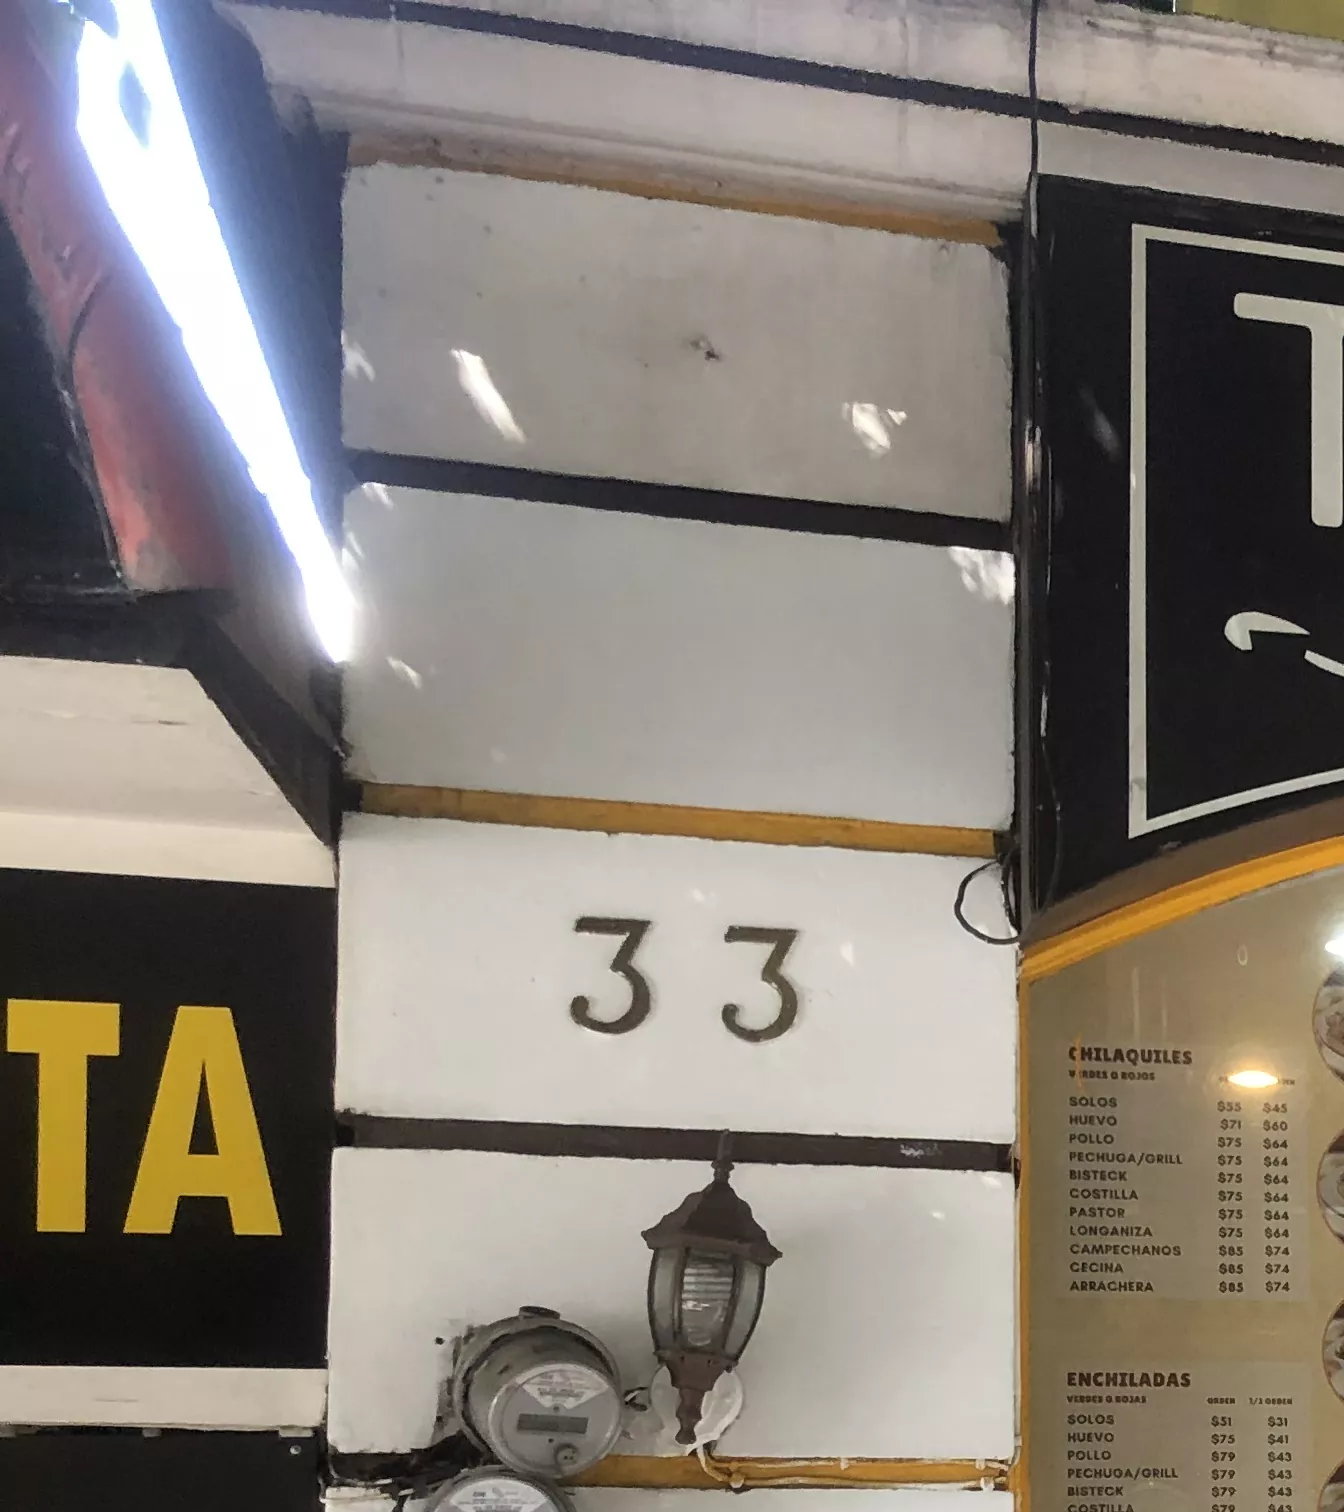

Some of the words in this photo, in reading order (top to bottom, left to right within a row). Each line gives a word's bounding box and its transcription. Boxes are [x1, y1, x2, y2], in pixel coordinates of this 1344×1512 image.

[1068, 1046, 1193, 1067] CHILAQUILES
[6, 999, 282, 1236] TA
[1069, 1114, 1117, 1127] HUEVO
[1219, 1118, 1242, 1131] $71
[1262, 1119, 1288, 1132] $60
[1069, 1151, 1183, 1166] PECHUGA/GRILL
[1217, 1153, 1243, 1167] $75
[1263, 1155, 1289, 1168] $64
[1067, 1371, 1191, 1388] ENCHILADAS
[1067, 1432, 1115, 1443] HUEVO
[1211, 1433, 1236, 1446] $75
[1267, 1433, 1289, 1446] $41
[1067, 1450, 1112, 1461] POLLO
[1211, 1450, 1236, 1463] $79
[1267, 1450, 1292, 1463] $43
